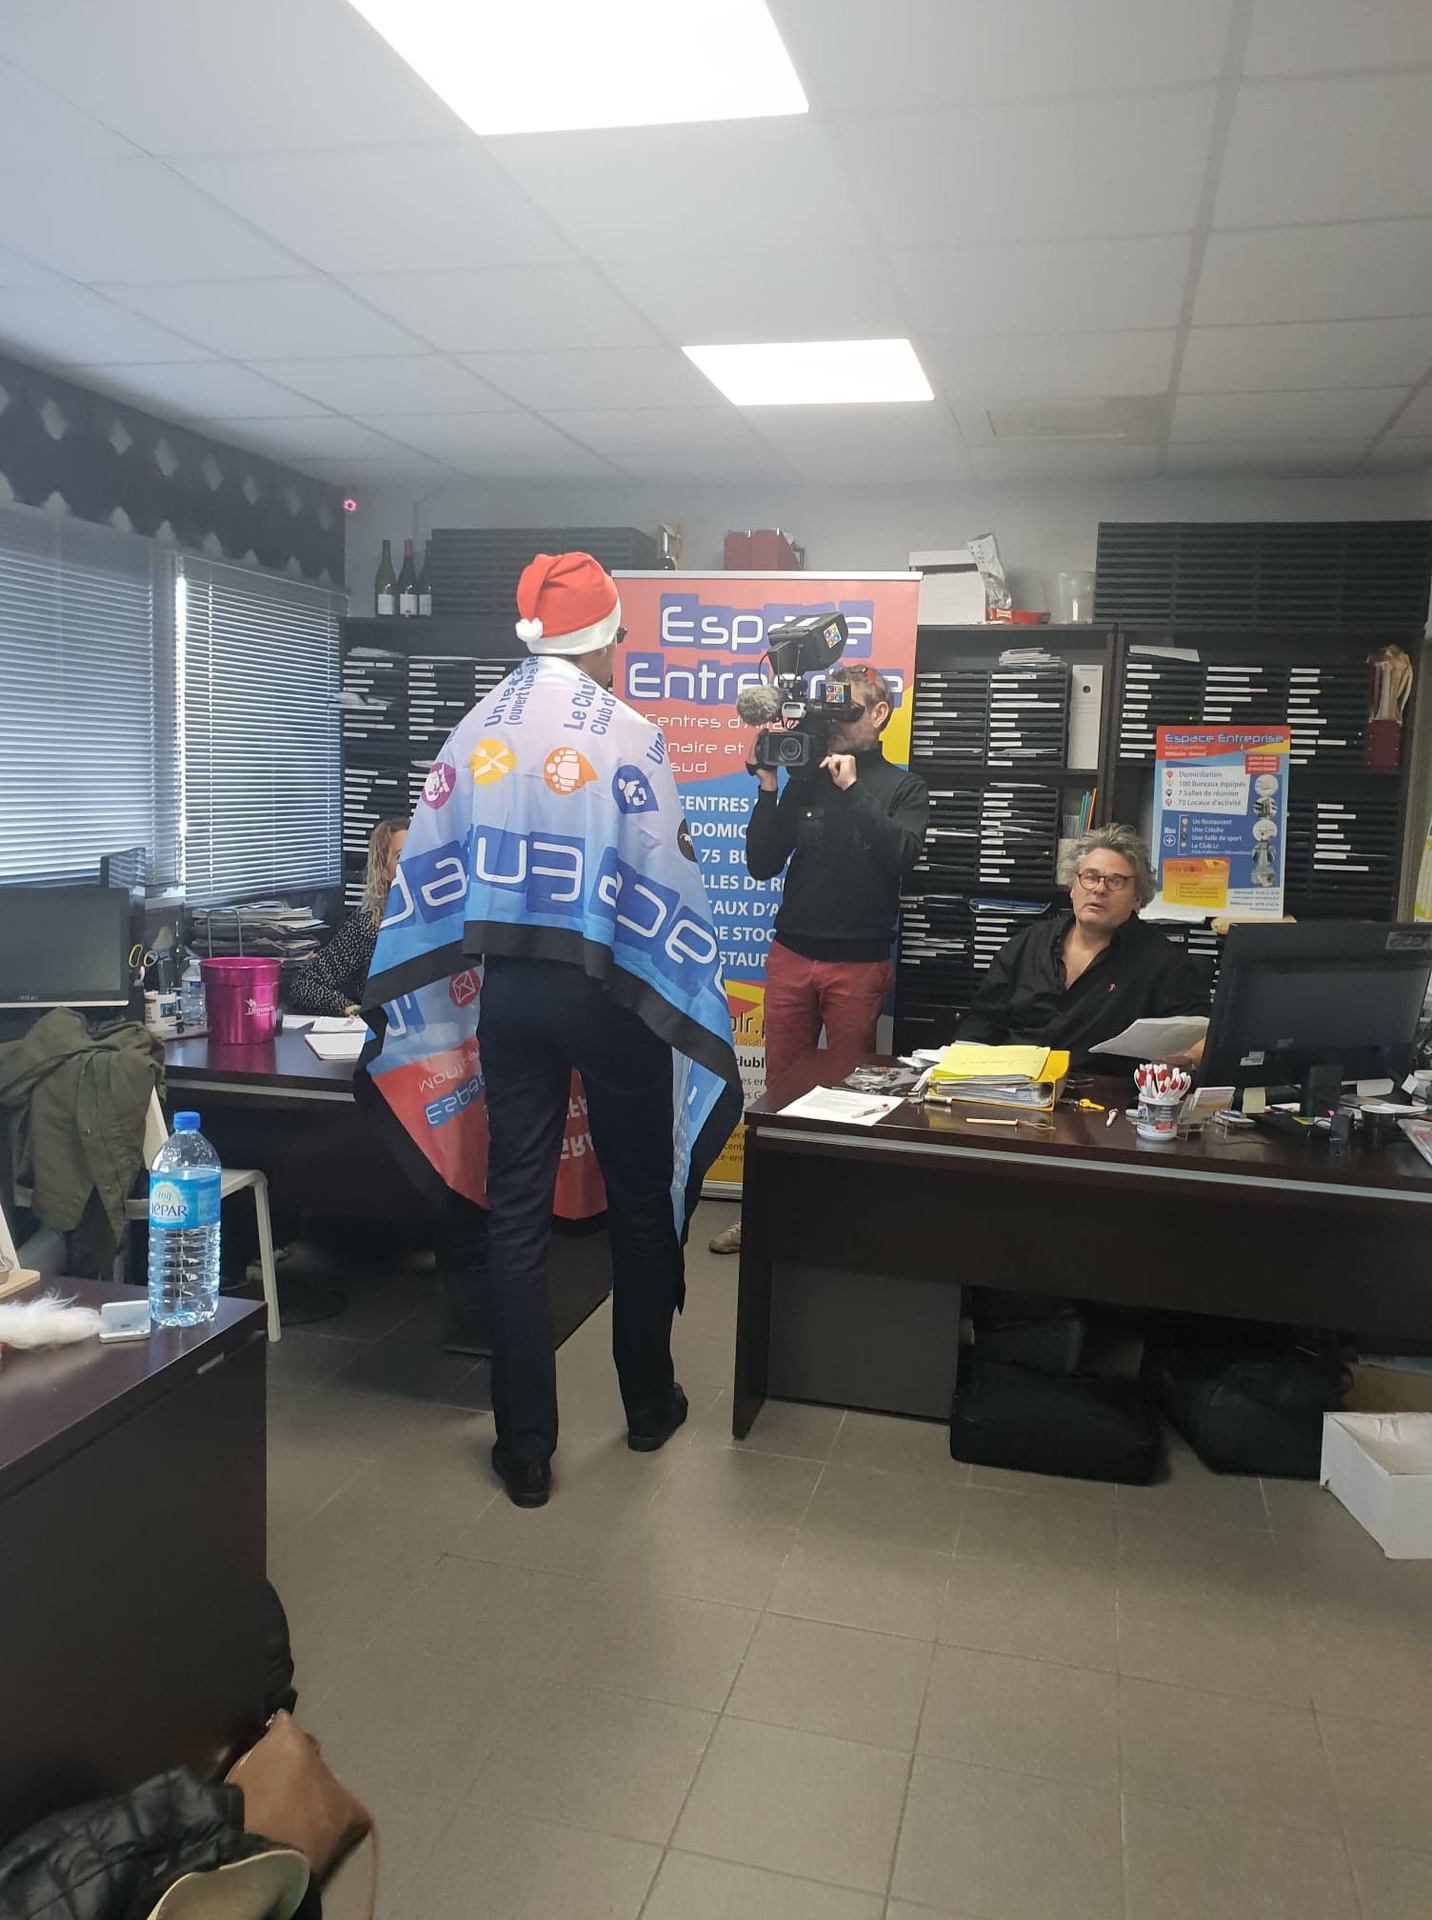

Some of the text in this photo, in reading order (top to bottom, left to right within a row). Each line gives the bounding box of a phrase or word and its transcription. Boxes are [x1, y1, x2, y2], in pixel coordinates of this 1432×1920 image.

[662, 606, 872, 650] Espe
[563, 711, 587, 731] Le
[590, 708, 614, 735] Club
[1165, 734, 1284, 744] Espace Entreprise
[667, 742, 745, 755] naire et
[701, 849, 721, 864] 75
[704, 875, 739, 891] LLES
[709, 900, 748, 916] AUX
[733, 928, 777, 942] STOC
